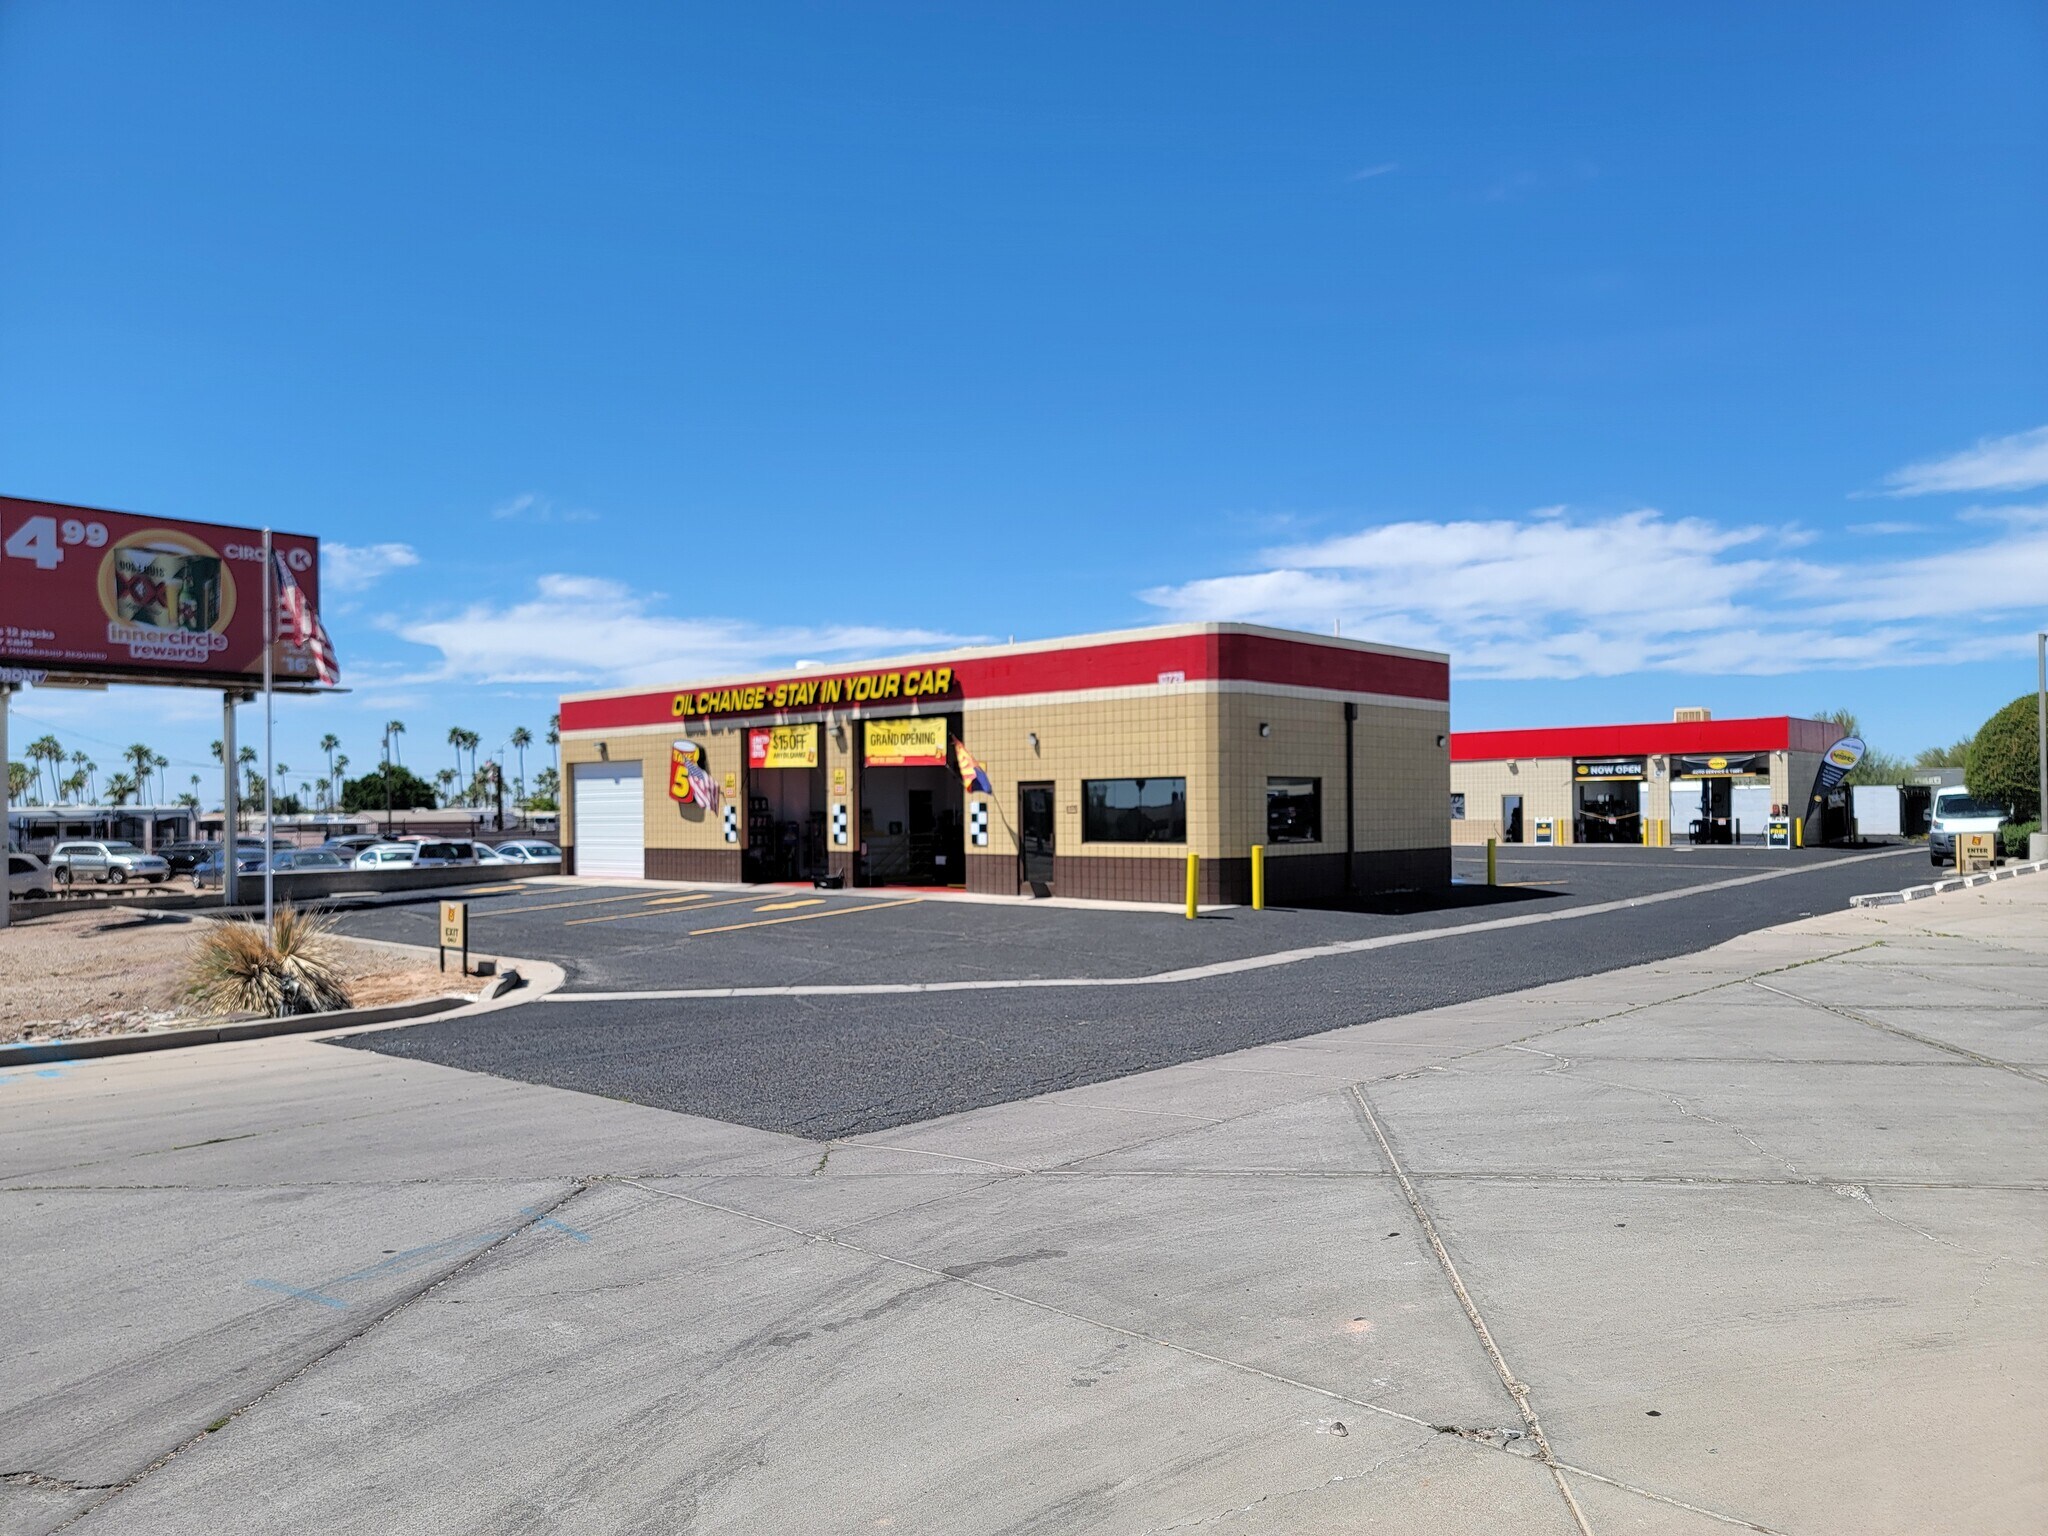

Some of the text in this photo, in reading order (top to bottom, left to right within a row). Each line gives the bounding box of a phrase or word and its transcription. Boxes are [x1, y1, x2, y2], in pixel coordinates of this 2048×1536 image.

[223, 543, 286, 562] CIRCE
[134, 643, 206, 660] rewards
[672, 667, 952, 717] OIL CHANGE STAY IN YOUR CAR
[773, 735, 788, 750] $15
[789, 734, 807, 750] OFF
[870, 732, 936, 746] GRAND OPENING
[1590, 765, 1614, 775] NOW
[1615, 764, 1641, 774] OPEN
[671, 765, 690, 798] 5
[445, 928, 458, 937] EXIT
